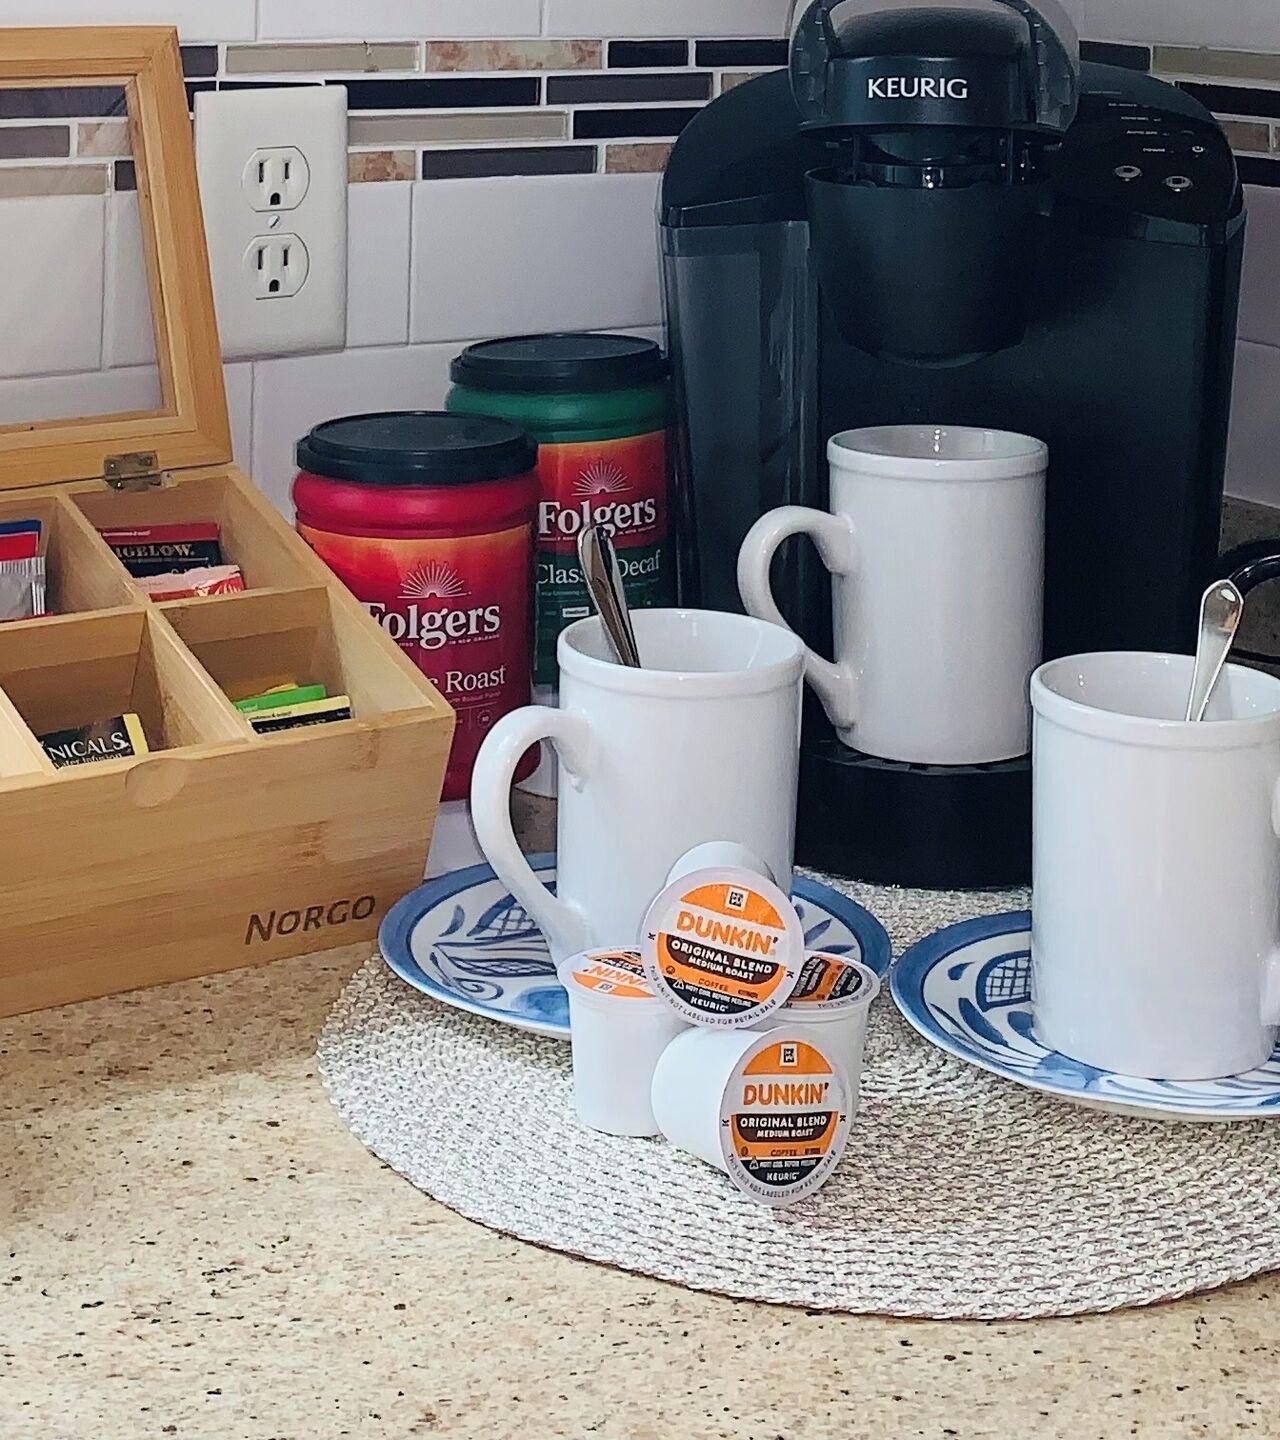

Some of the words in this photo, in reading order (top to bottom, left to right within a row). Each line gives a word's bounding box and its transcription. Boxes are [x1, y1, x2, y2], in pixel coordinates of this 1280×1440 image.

[867, 77, 969, 100] KEURIG
[537, 497, 657, 539] Folgers
[616, 548, 661, 578] Decaf
[445, 664, 507, 694] Roast
[244, 895, 376, 946] NORGO
[675, 910, 780, 956] DUNKIN'
[671, 939, 730, 968] ORIGINAL
[732, 957, 773, 974] BLEND
[688, 955, 725, 973] MEDIUM
[725, 965, 755, 981] ROAST
[683, 1008, 716, 1024] LABELED
[690, 996, 728, 1012] KEURIG
[743, 1082, 830, 1107] DUNKIN'
[740, 1116, 794, 1128] ORIGINAL
[797, 1115, 827, 1127] BLEND
[756, 1129, 790, 1138] MEDIUM
[791, 1128, 814, 1138] ROAST
[766, 1171, 799, 1182] KEURIG
